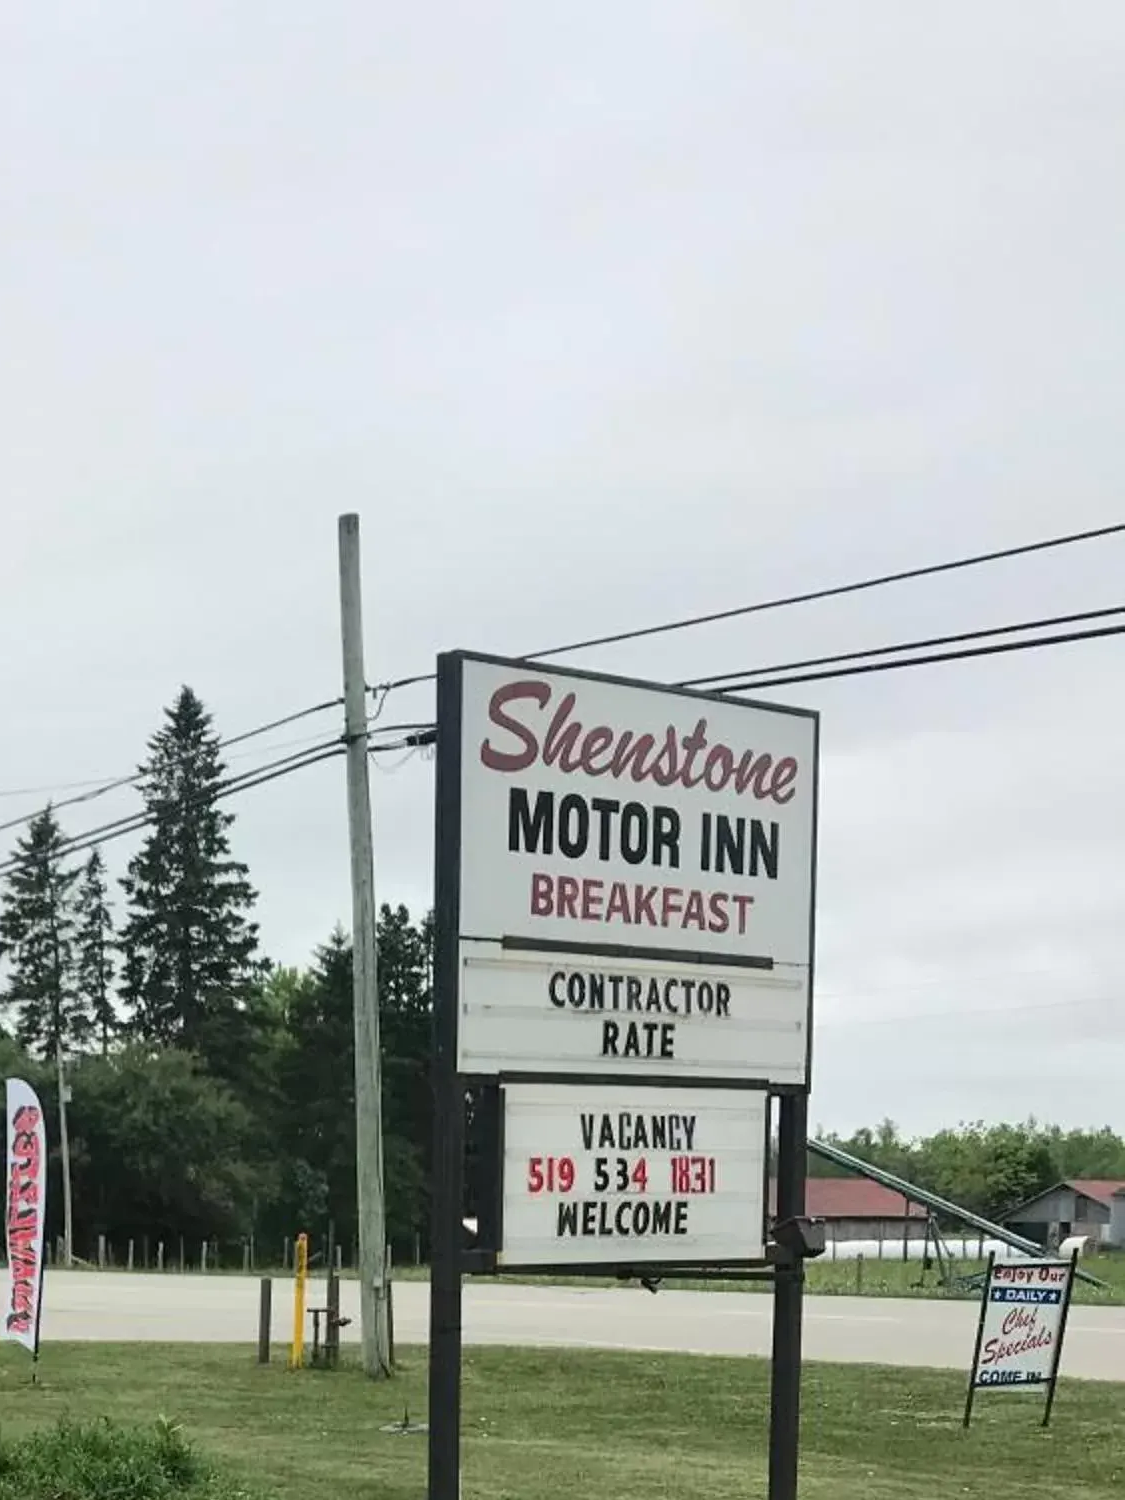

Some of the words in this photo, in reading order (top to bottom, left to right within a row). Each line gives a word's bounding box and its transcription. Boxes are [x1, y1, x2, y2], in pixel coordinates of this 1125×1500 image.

[480, 680, 799, 805] Shenstone
[508, 787, 680, 869] MOTOR
[700, 811, 779, 881] INN
[530, 872, 755, 935] BREAKFAST
[548, 970, 731, 1017] CONTRACTOR
[601, 1018, 676, 1059] RATE
[579, 1112, 697, 1150] VACANCY
[528, 1156, 575, 1193] 519
[594, 1156, 648, 1194] 534
[670, 1157, 716, 1194] 1831
[557, 1201, 689, 1237] WELCOME
[1038, 1267, 1067, 1283] Our
[1005, 1289, 1048, 1301] DAILY
[1002, 1306, 1038, 1335] Chef
[981, 1326, 1053, 1366] Specials
[979, 1370, 1022, 1385] COME
